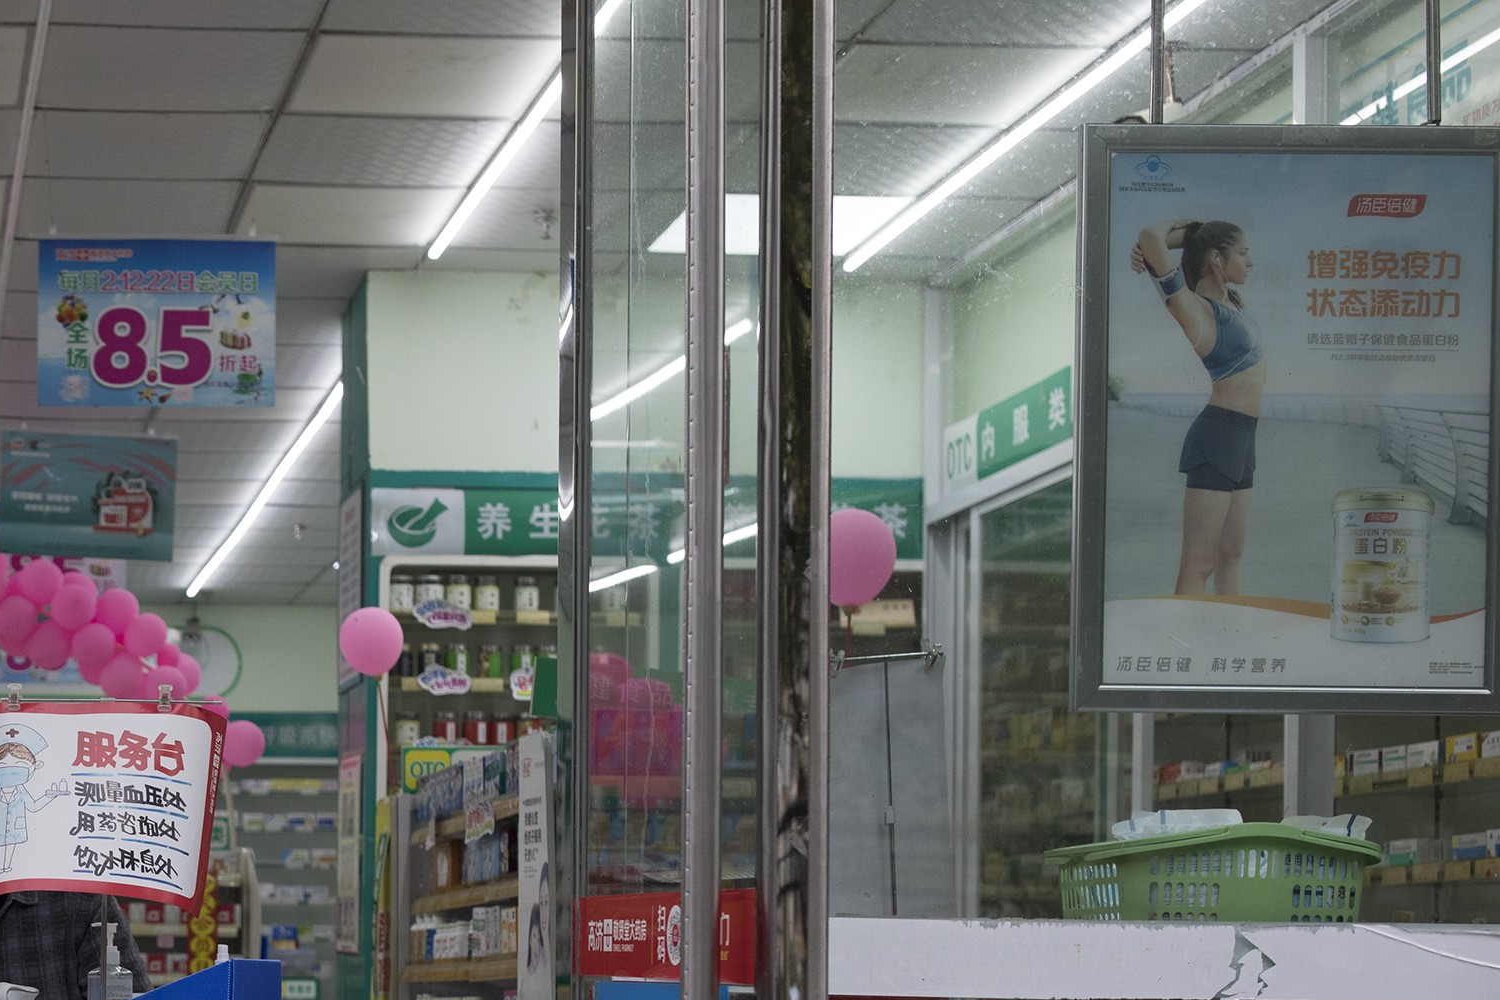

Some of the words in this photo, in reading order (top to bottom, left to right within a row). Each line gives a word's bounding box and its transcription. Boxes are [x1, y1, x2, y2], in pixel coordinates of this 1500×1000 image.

[1356, 197, 1418, 214] 汤臣倍健
[1306, 250, 1461, 281] 增强免疫力
[1306, 288, 1461, 318] 状态添动力
[66, 320, 89, 371] 全场
[92, 307, 213, 387] 8.5
[1306, 333, 1460, 347] 请选蓝帽子保健食品蛋白粉
[219, 354, 259, 373] 折起
[1354, 538, 1407, 555] 蛋白粉
[1116, 655, 1192, 673] 汤臣倍健
[1211, 656, 1287, 673] 科学营养
[71, 730, 185, 777] 服务台
[74, 780, 187, 813] 测量血压处
[69, 810, 182, 842] 用药咨询处
[73, 845, 180, 880] 饮水休息处
[613, 918, 647, 942] 敬贤堂大药房
[657, 904, 667, 964] 扫码
